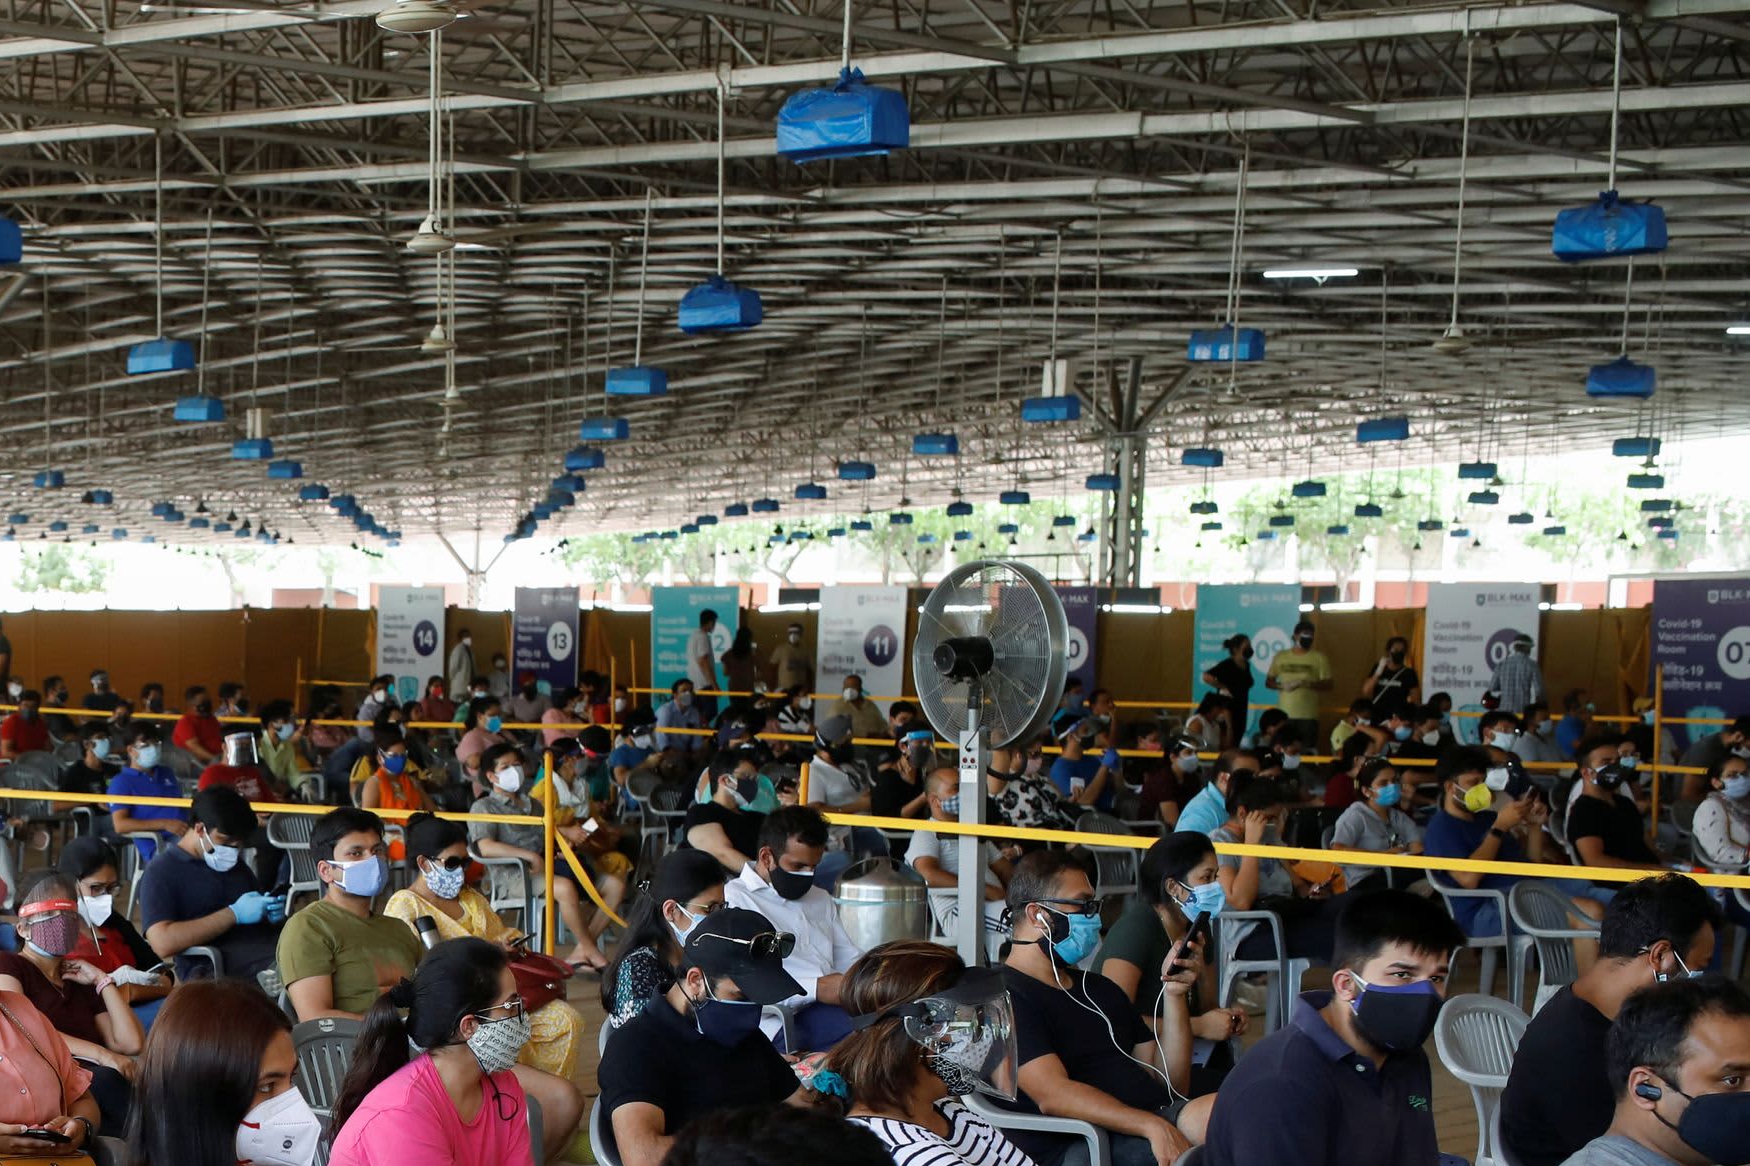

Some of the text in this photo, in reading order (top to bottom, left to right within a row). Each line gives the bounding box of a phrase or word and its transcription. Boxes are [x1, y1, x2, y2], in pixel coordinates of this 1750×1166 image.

[1658, 618, 1703, 629] Covid-19
[417, 630, 434, 648] 14
[552, 632, 567, 650] 13
[1658, 631, 1716, 641] Vaccination
[872, 636, 890, 656] 11
[1657, 644, 1687, 654] Room
